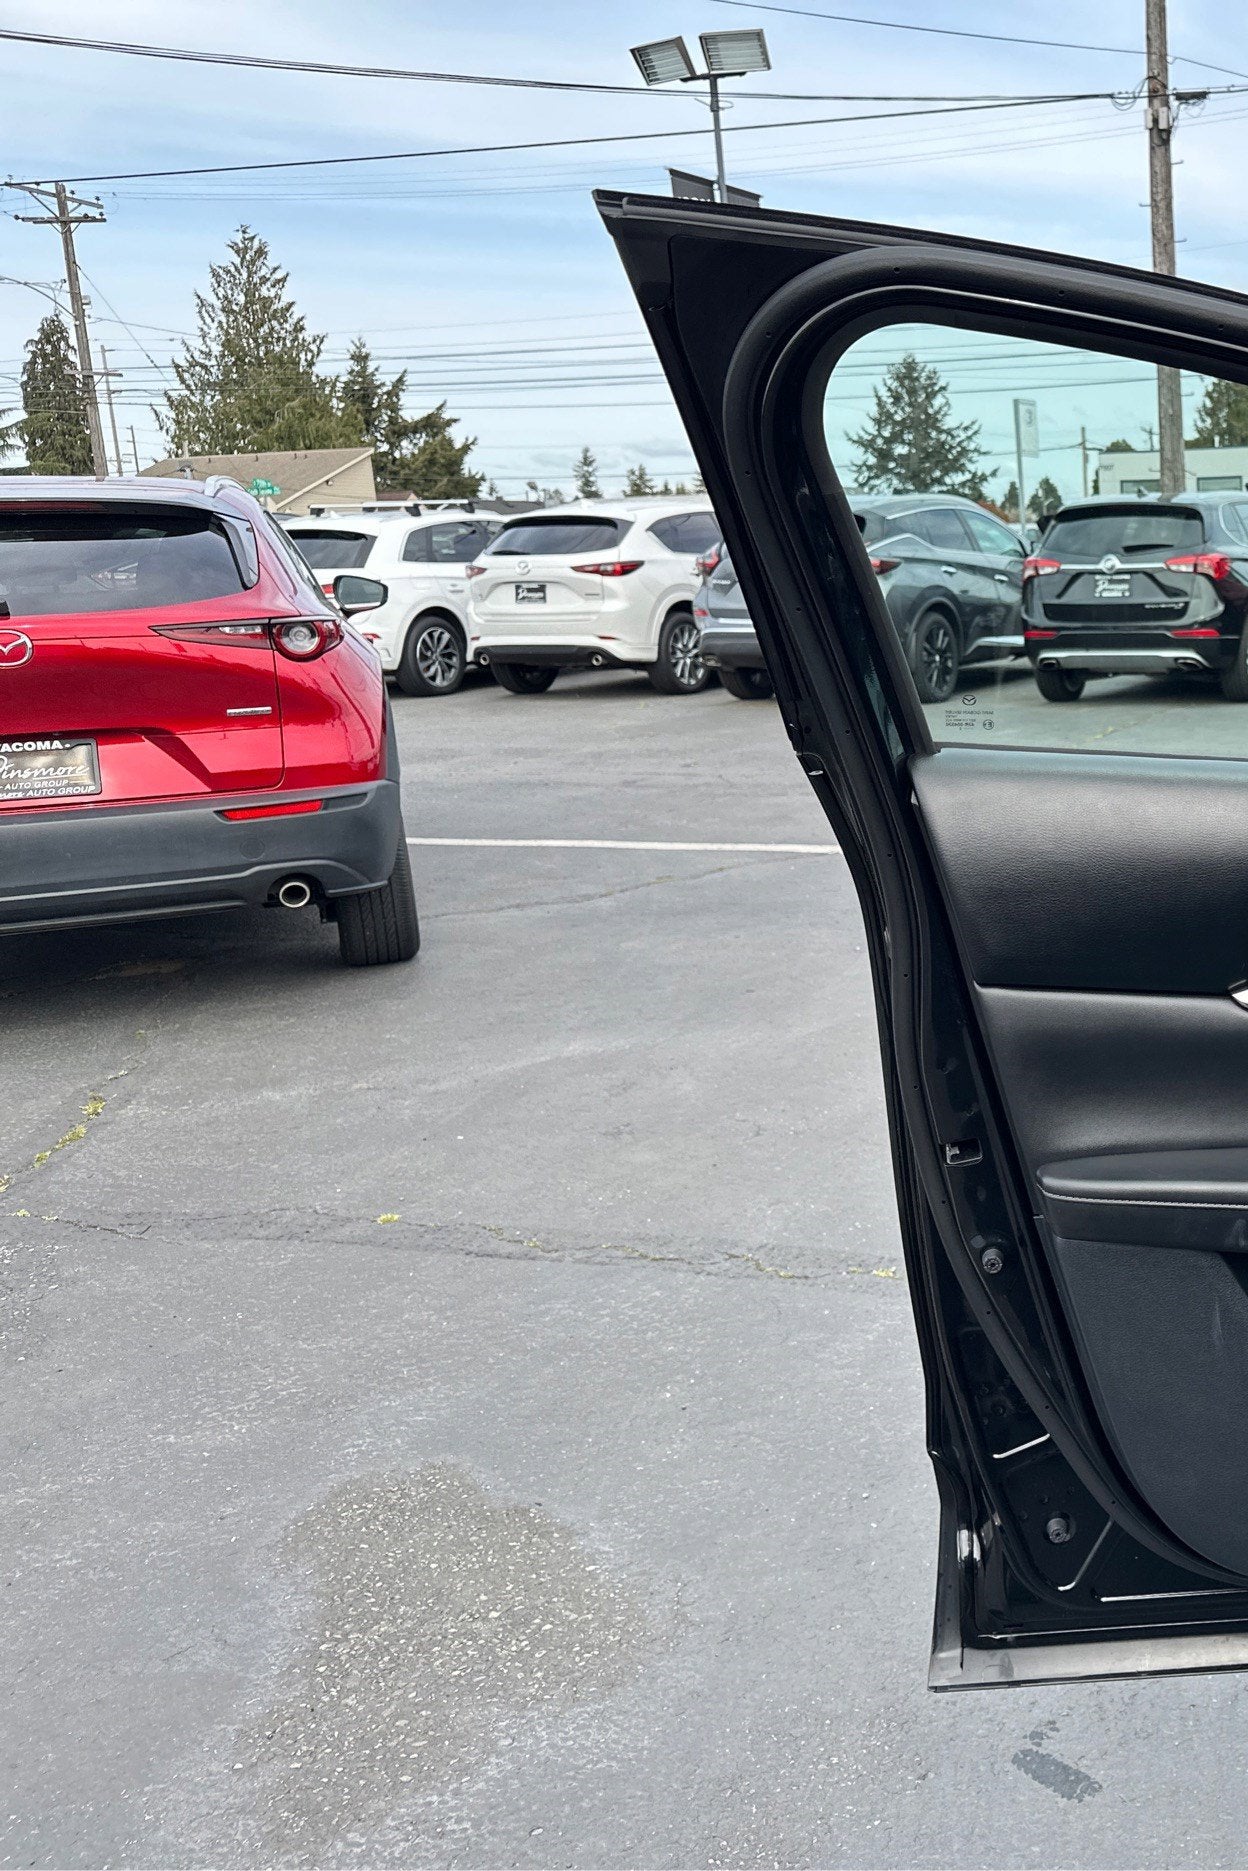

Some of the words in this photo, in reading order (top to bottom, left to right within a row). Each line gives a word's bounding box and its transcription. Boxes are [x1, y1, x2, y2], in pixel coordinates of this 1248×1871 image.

[0, 740, 63, 753] ACOMA
[0, 755, 90, 779] insmore
[4, 782, 32, 791] AUTO
[34, 780, 69, 789] GROUP
[26, 789, 56, 797] AUTO
[58, 785, 96, 794] GROUP
